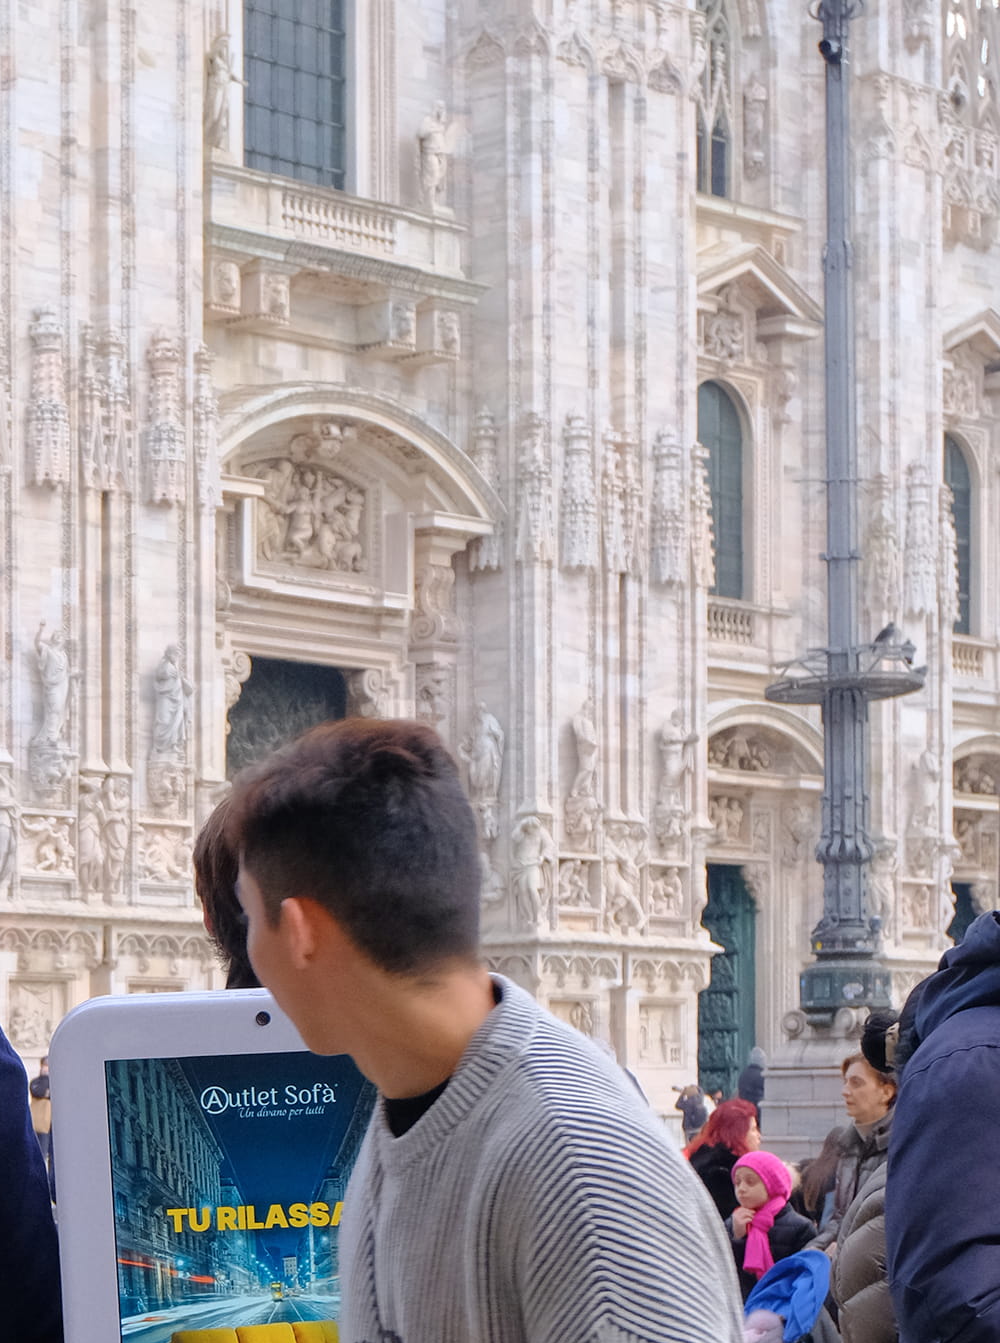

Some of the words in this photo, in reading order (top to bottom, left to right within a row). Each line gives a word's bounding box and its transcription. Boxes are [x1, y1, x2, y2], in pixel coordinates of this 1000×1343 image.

[284, 1083, 336, 1105] Sofà
[239, 1106, 255, 1118] Un
[256, 1105, 287, 1118] divano
[288, 1108, 304, 1120] per
[305, 1105, 325, 1115] tutti
[167, 1208, 210, 1233] TU
